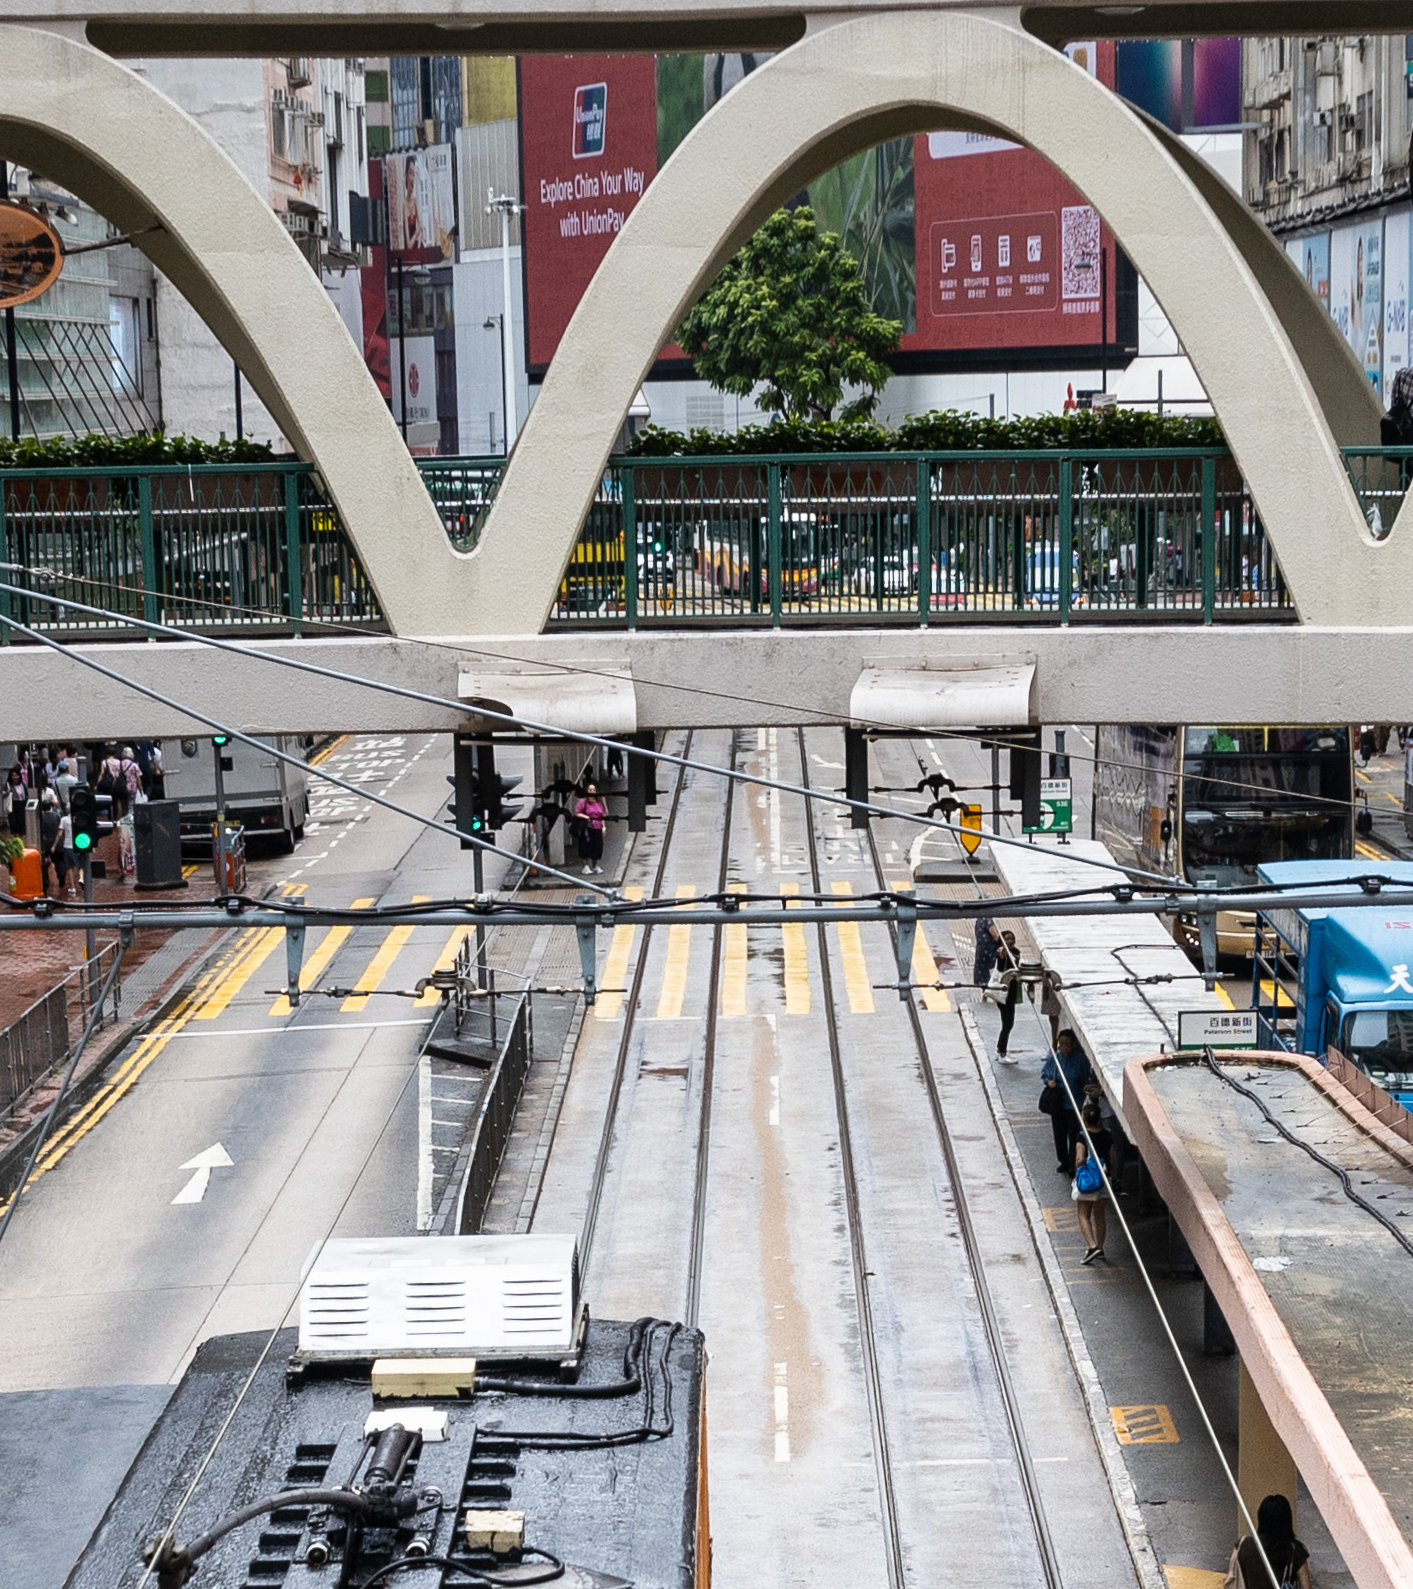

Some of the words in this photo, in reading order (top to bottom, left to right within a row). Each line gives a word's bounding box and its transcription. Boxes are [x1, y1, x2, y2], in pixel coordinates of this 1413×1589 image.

[540, 176, 573, 208] Explore
[574, 173, 599, 200] China
[600, 170, 622, 196] Your
[623, 167, 644, 198] Way
[559, 212, 580, 238] with
[582, 207, 624, 235] UnionPay
[1203, 1028, 1232, 1036] Paterson
[1233, 1027, 1253, 1035] Street
[1209, 1016, 1253, 1028] 百德新街
